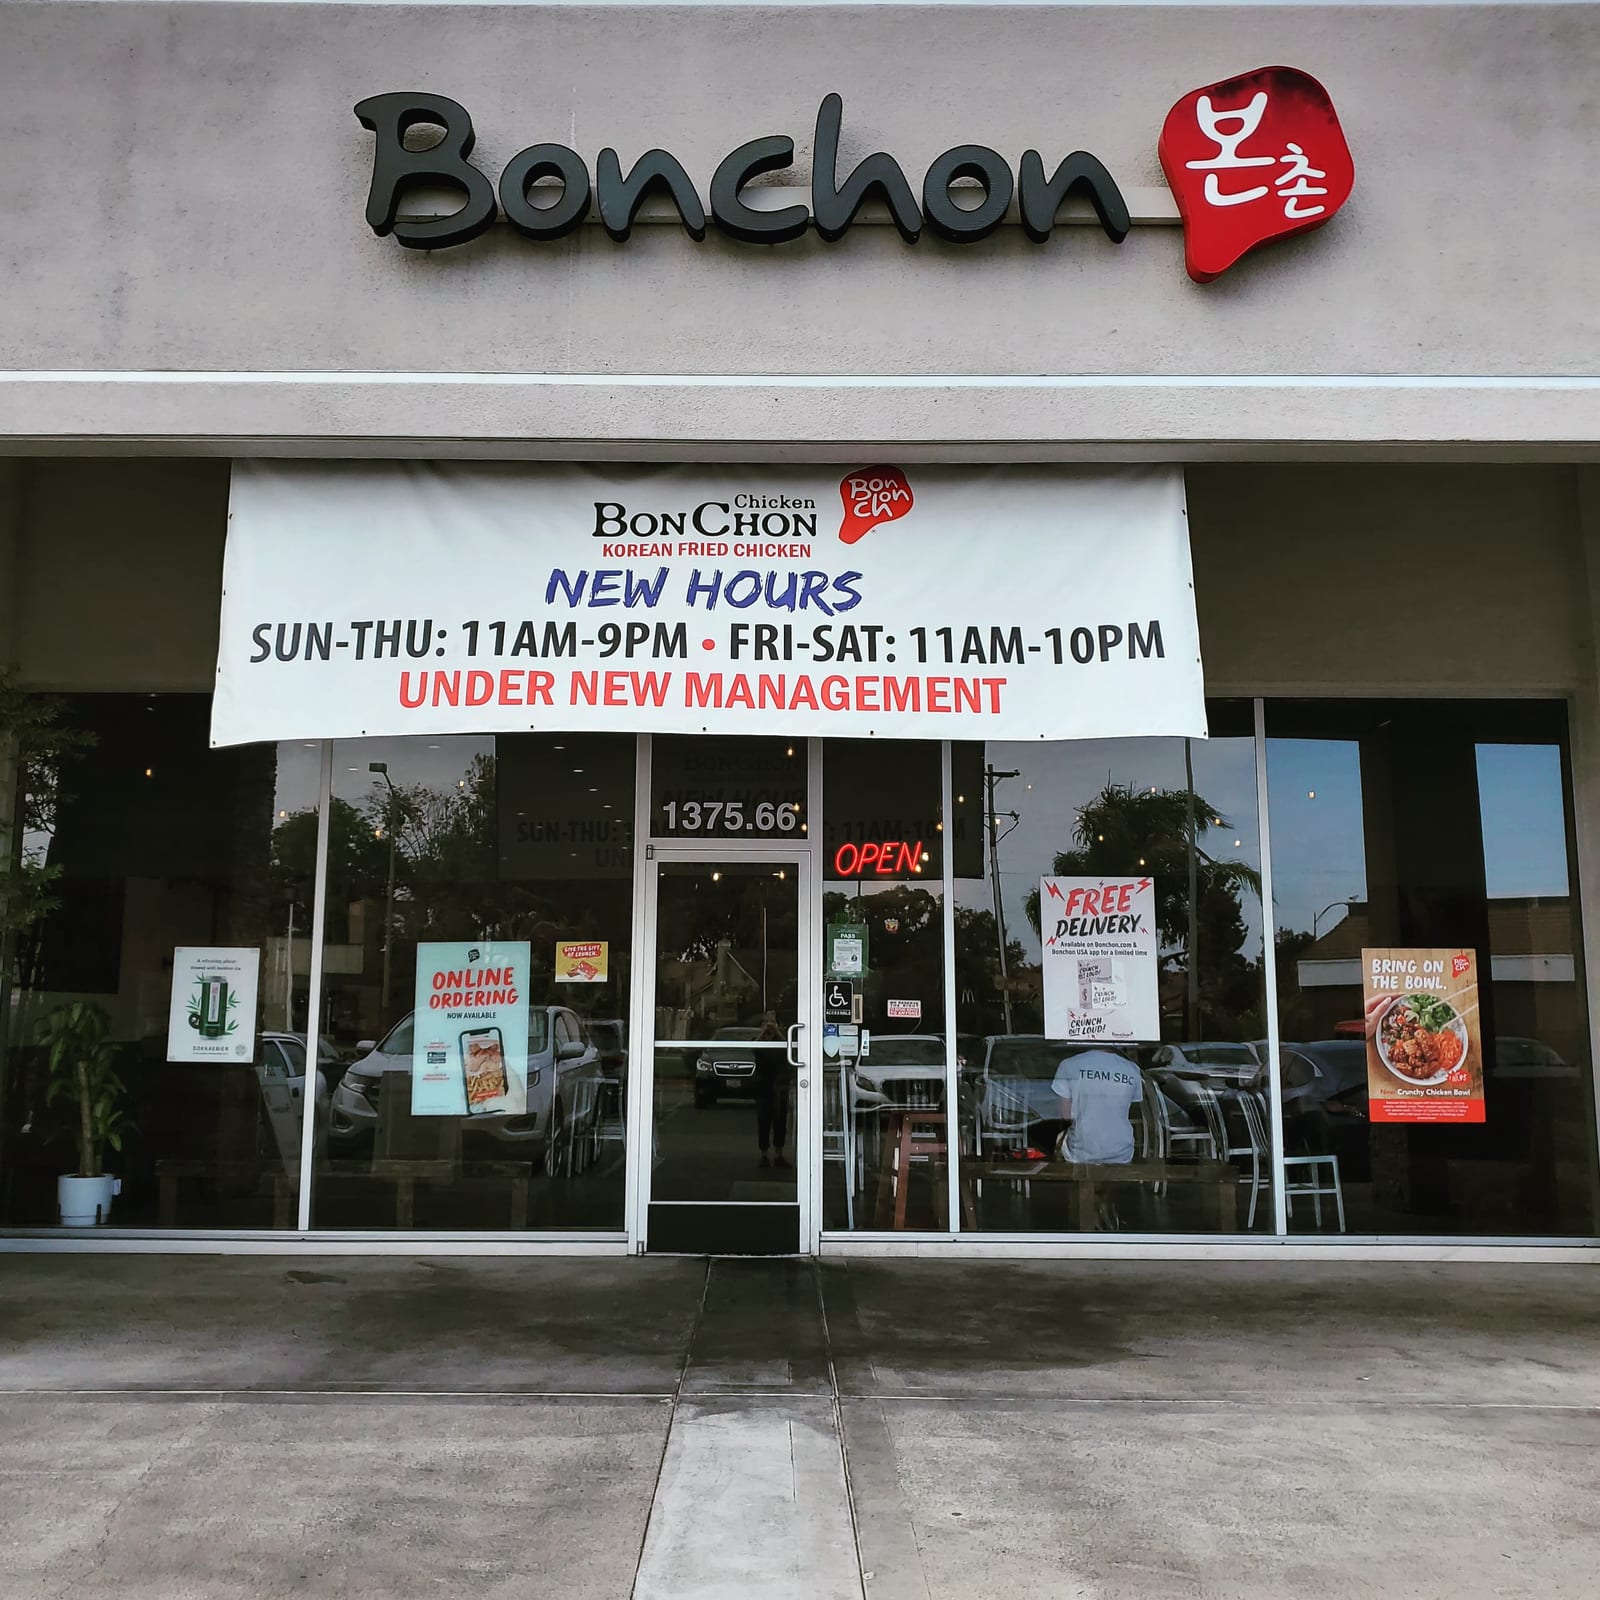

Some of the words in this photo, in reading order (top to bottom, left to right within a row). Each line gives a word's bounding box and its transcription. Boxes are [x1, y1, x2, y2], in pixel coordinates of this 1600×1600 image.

[353, 92, 1131, 249] Bonchon
[734, 494, 816, 509] Chicken
[603, 543, 673, 558] KOREAN
[678, 542, 729, 557] FRIED
[733, 543, 811, 558] CHICKEN
[544, 566, 670, 609] NEW
[686, 569, 864, 617] HOURS
[250, 620, 447, 663] SUN-THU:
[461, 621, 688, 660] 11AM-9PM
[730, 623, 896, 664] FRI-SAT:
[909, 620, 1166, 665] 11AM-10PM
[398, 669, 555, 708] UNDER
[569, 672, 672, 708] NEW
[684, 672, 1007, 714] MANAGEMENT
[663, 801, 796, 831] 1375.66
[835, 841, 922, 876] OPEN
[1065, 884, 1134, 917] FREE
[1055, 914, 1142, 938] DELIVERY
[1372, 958, 1417, 973] BRING
[1423, 960, 1444, 973] ON
[432, 967, 514, 990] ONLINE
[1372, 975, 1399, 989] THE
[1405, 975, 1447, 990] BOWL.
[429, 988, 519, 1010] ORDERING
[447, 1012, 463, 1020] NOW
[463, 1011, 497, 1019] AVAILABLE
[1070, 1017, 1102, 1028] CRUNCH
[1069, 1027, 1081, 1036] OUT
[1082, 1024, 1106, 1035] LOUD!
[1080, 1069, 1111, 1081] TEAM
[1397, 1089, 1425, 1097] Crunchy
